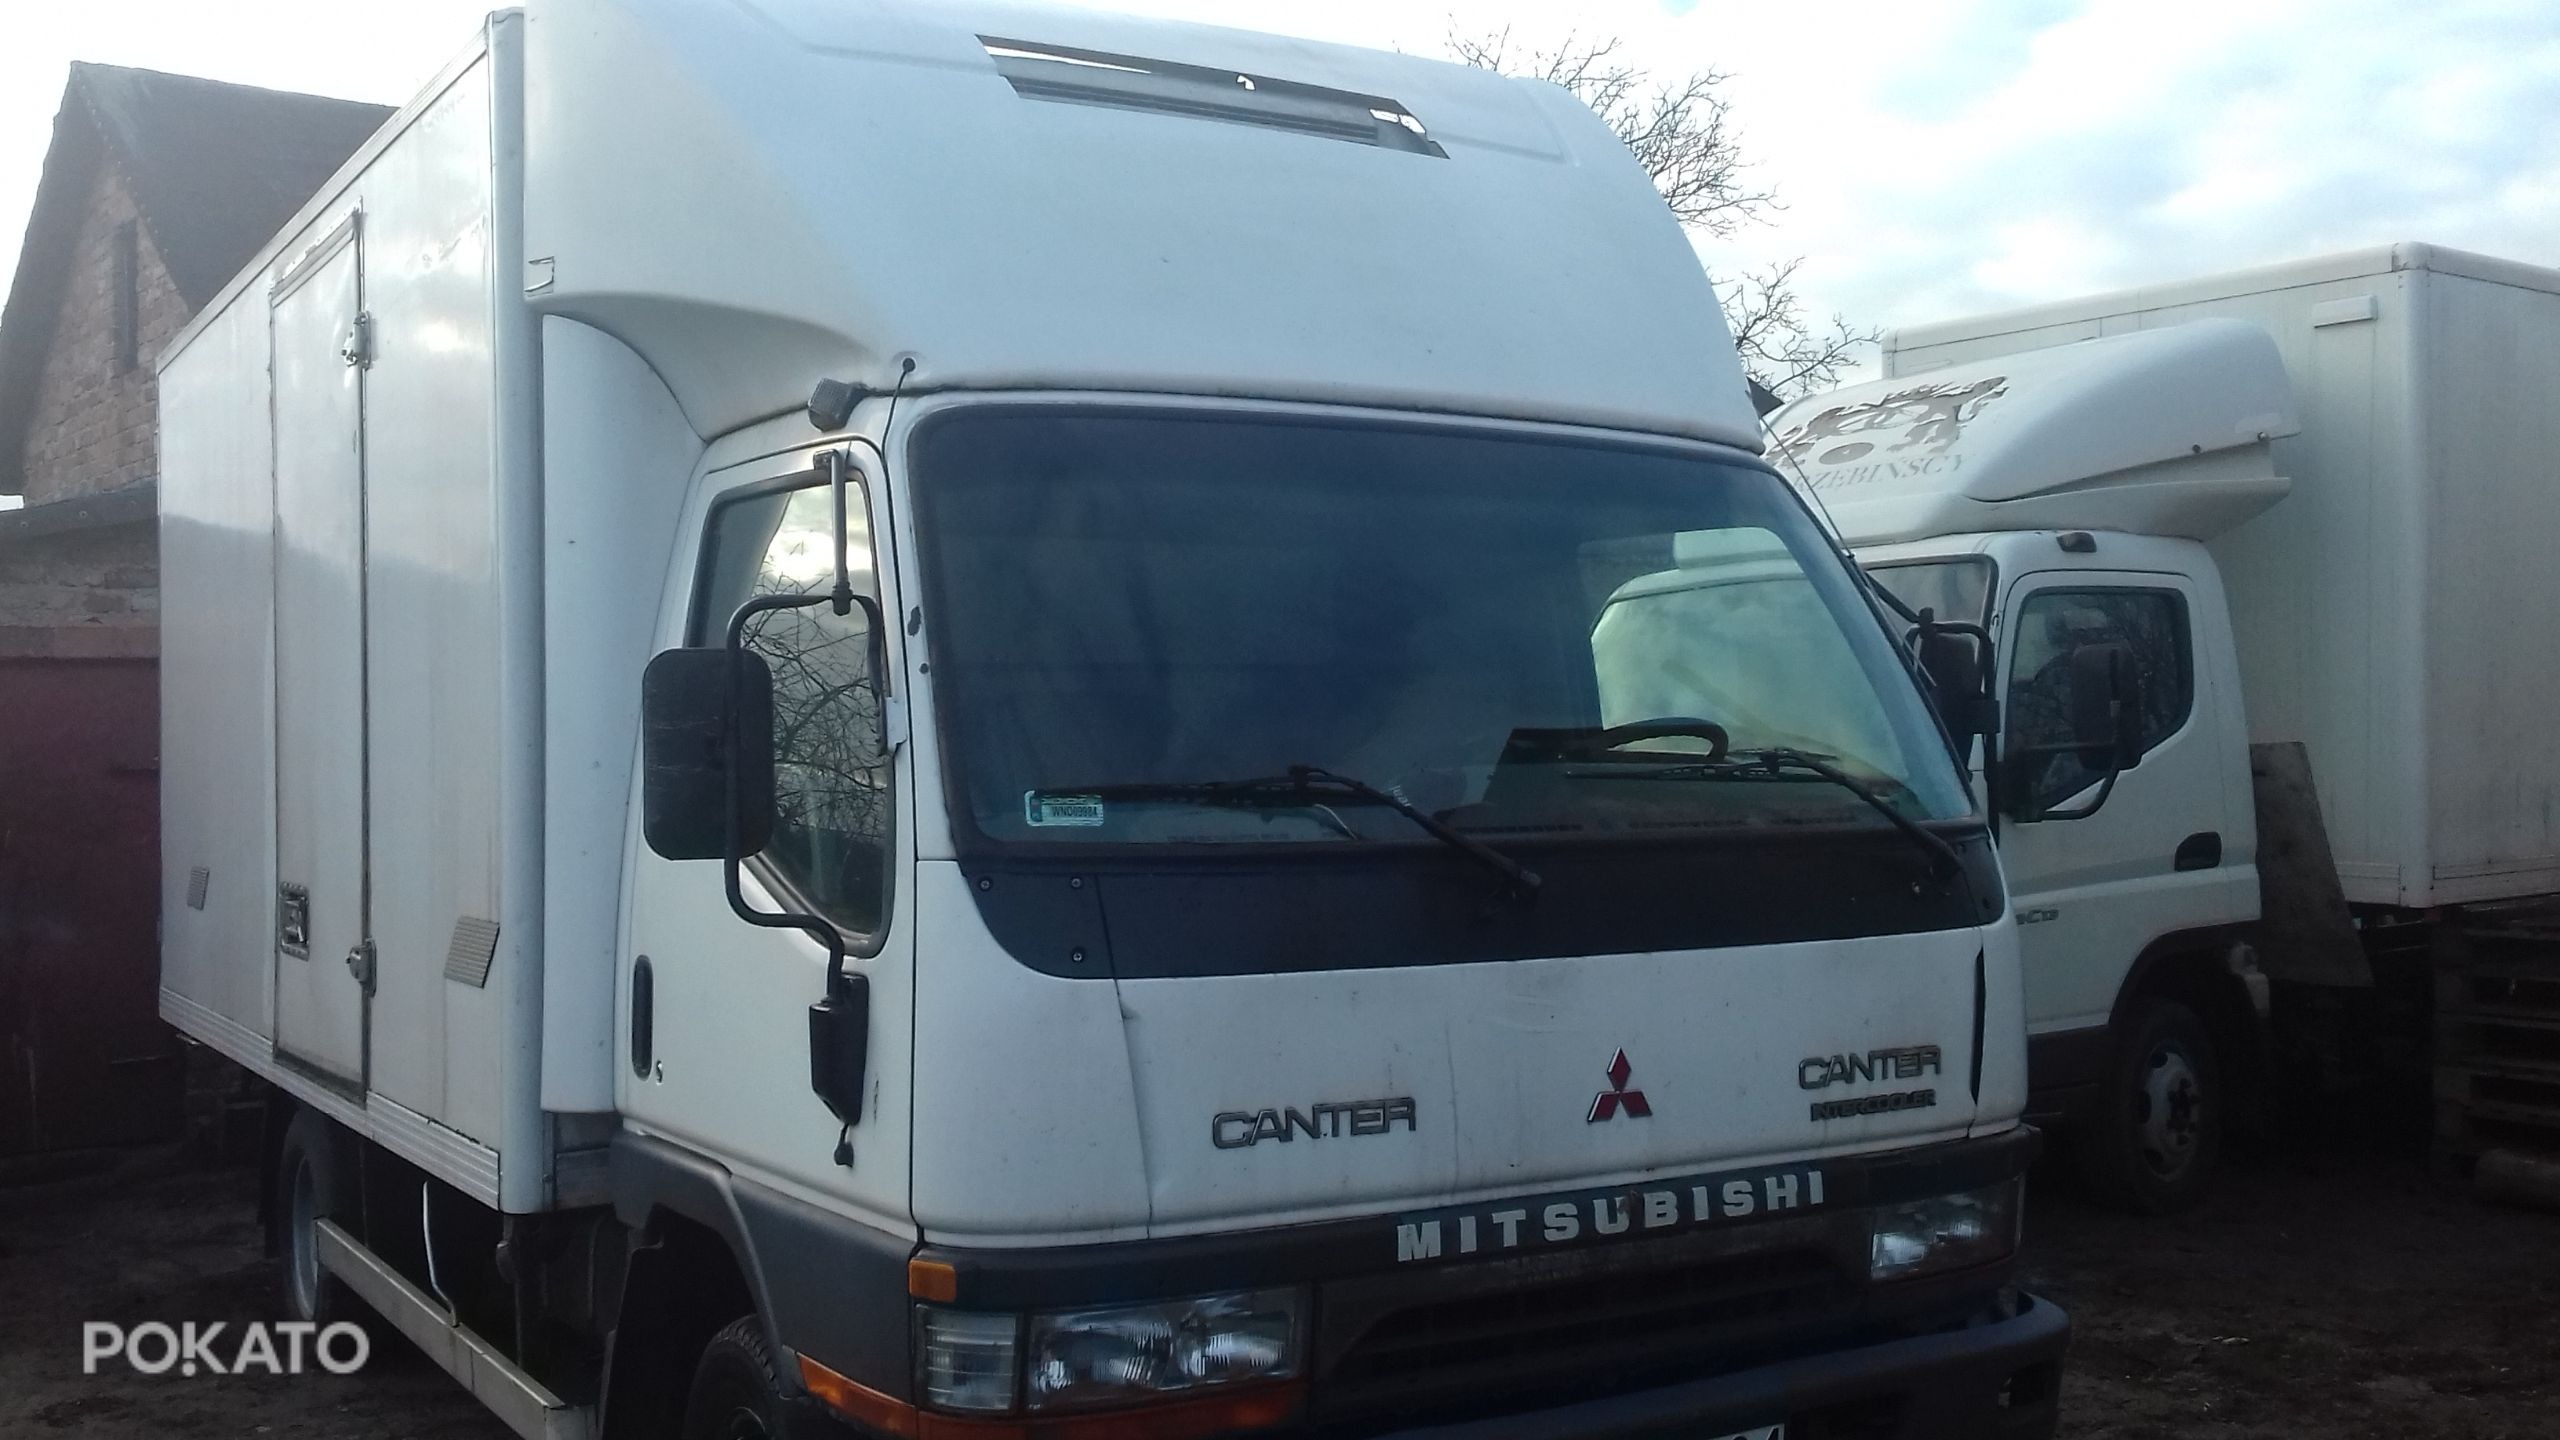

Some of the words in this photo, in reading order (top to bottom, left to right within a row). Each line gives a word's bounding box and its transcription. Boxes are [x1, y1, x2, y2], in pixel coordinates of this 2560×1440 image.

[1799, 1044, 1942, 1090] CANTER
[1212, 1096, 1416, 1150] CANTER
[1810, 1088, 1937, 1122] INTERCOOLER
[1396, 1170, 1825, 1263] MITSUBISHI
